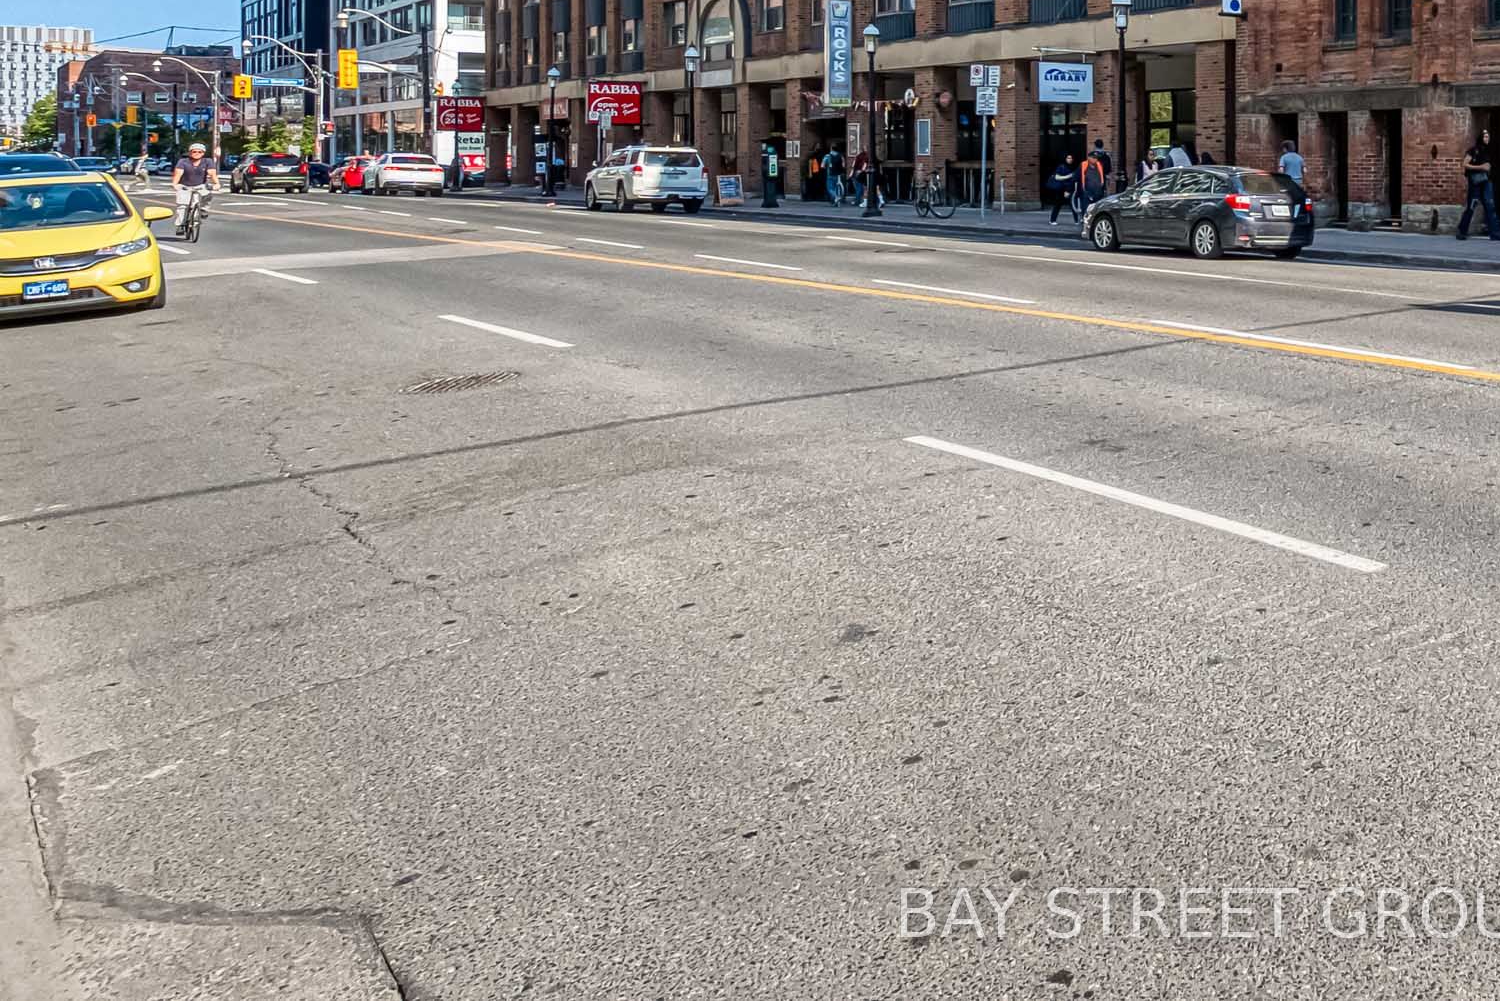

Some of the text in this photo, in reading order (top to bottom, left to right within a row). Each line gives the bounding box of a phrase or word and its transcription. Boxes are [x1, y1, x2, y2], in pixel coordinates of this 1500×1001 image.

[833, 27, 848, 83] ROCKS
[1044, 73, 1088, 82] LIBRARY
[590, 83, 640, 95] RABBA
[440, 98, 481, 108] RABBA
